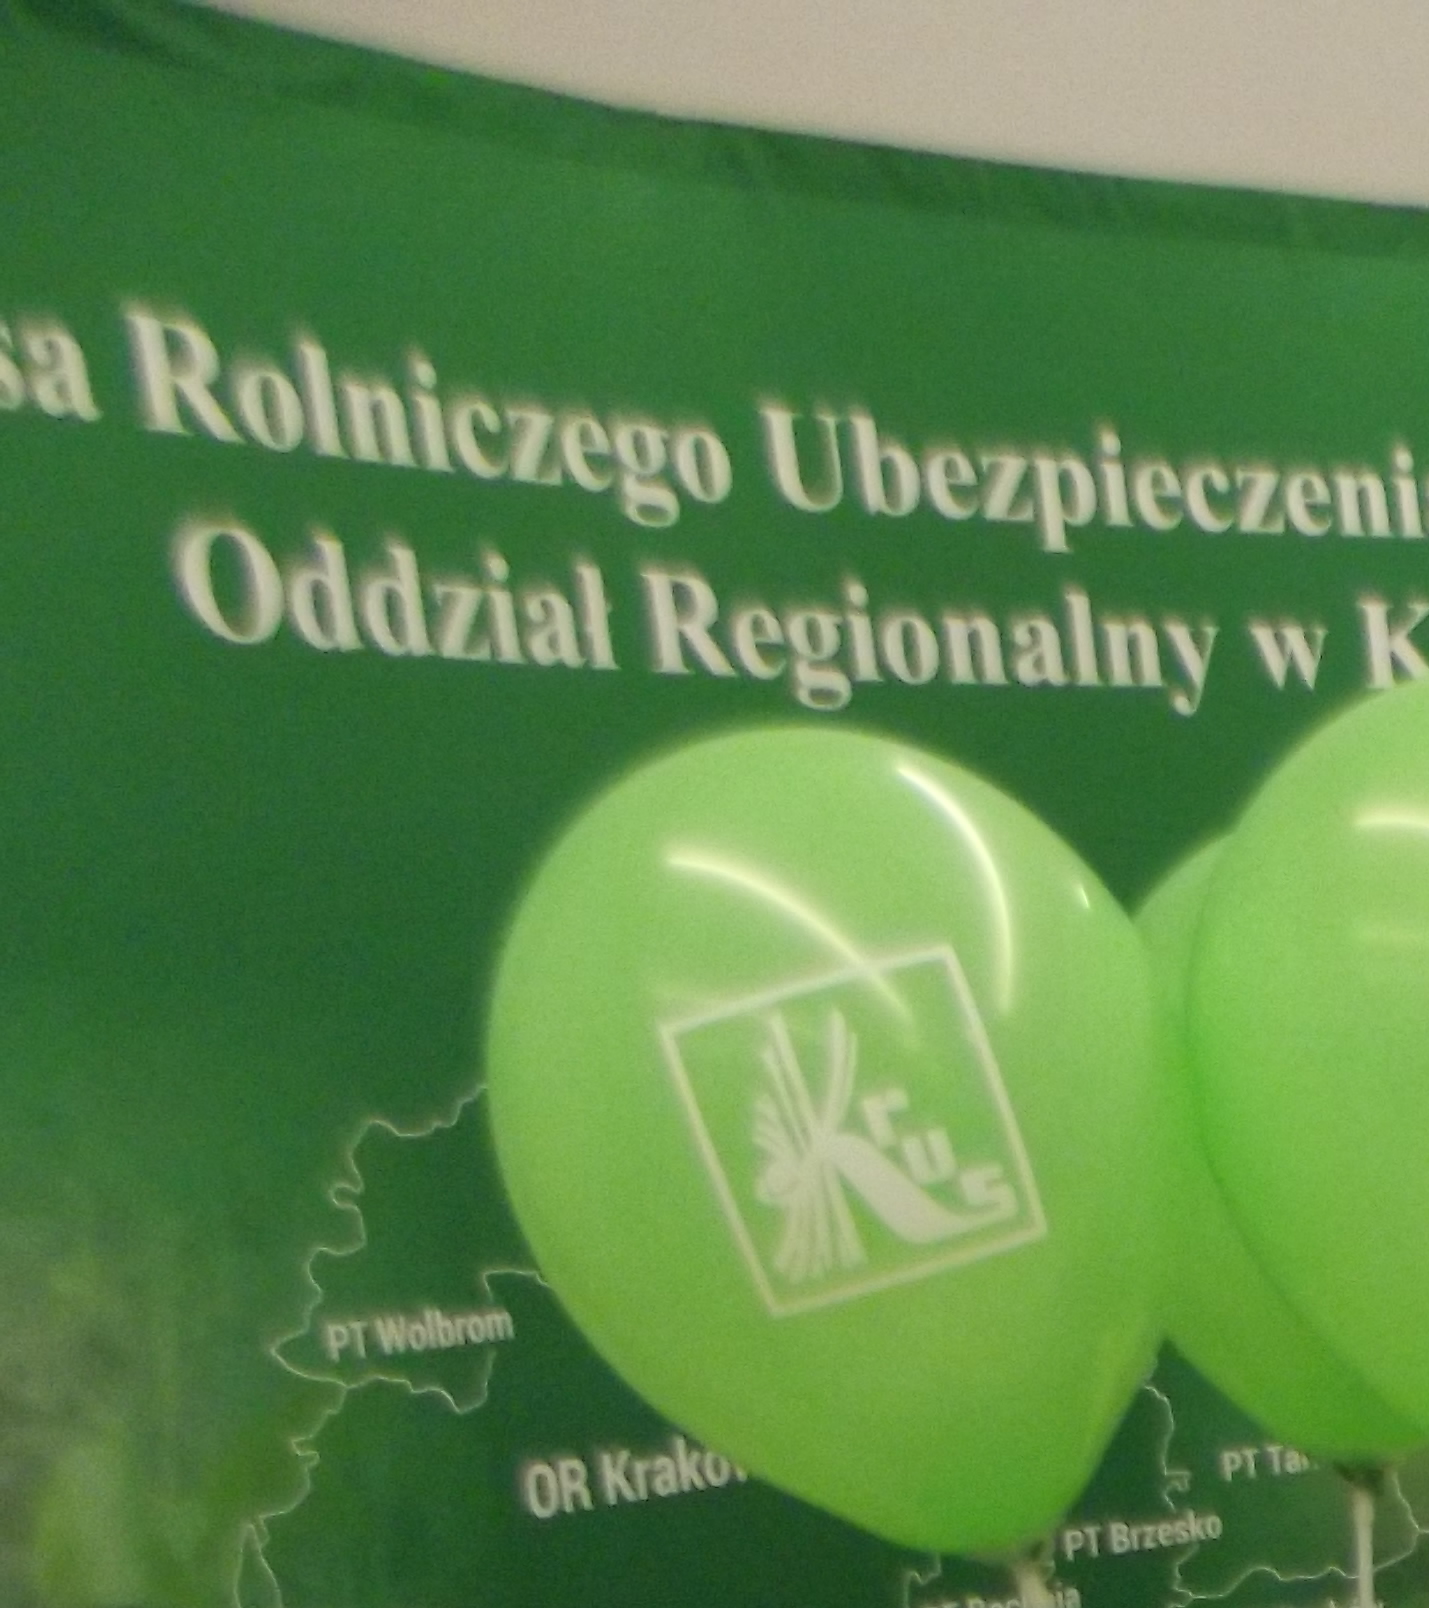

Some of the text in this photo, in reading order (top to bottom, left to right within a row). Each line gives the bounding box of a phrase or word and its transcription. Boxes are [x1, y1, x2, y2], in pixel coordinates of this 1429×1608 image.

[120, 300, 734, 528] Rolniczego
[172, 512, 620, 672] Oddział
[640, 563, 1218, 715] Regionalny
[1248, 616, 1328, 690] w
[326, 1306, 515, 1363] PT Wolbrom
[523, 1433, 749, 1520] OR Krako
[1220, 1446, 1259, 1482] PT
[1064, 1508, 1224, 1562] PT Brzesko
